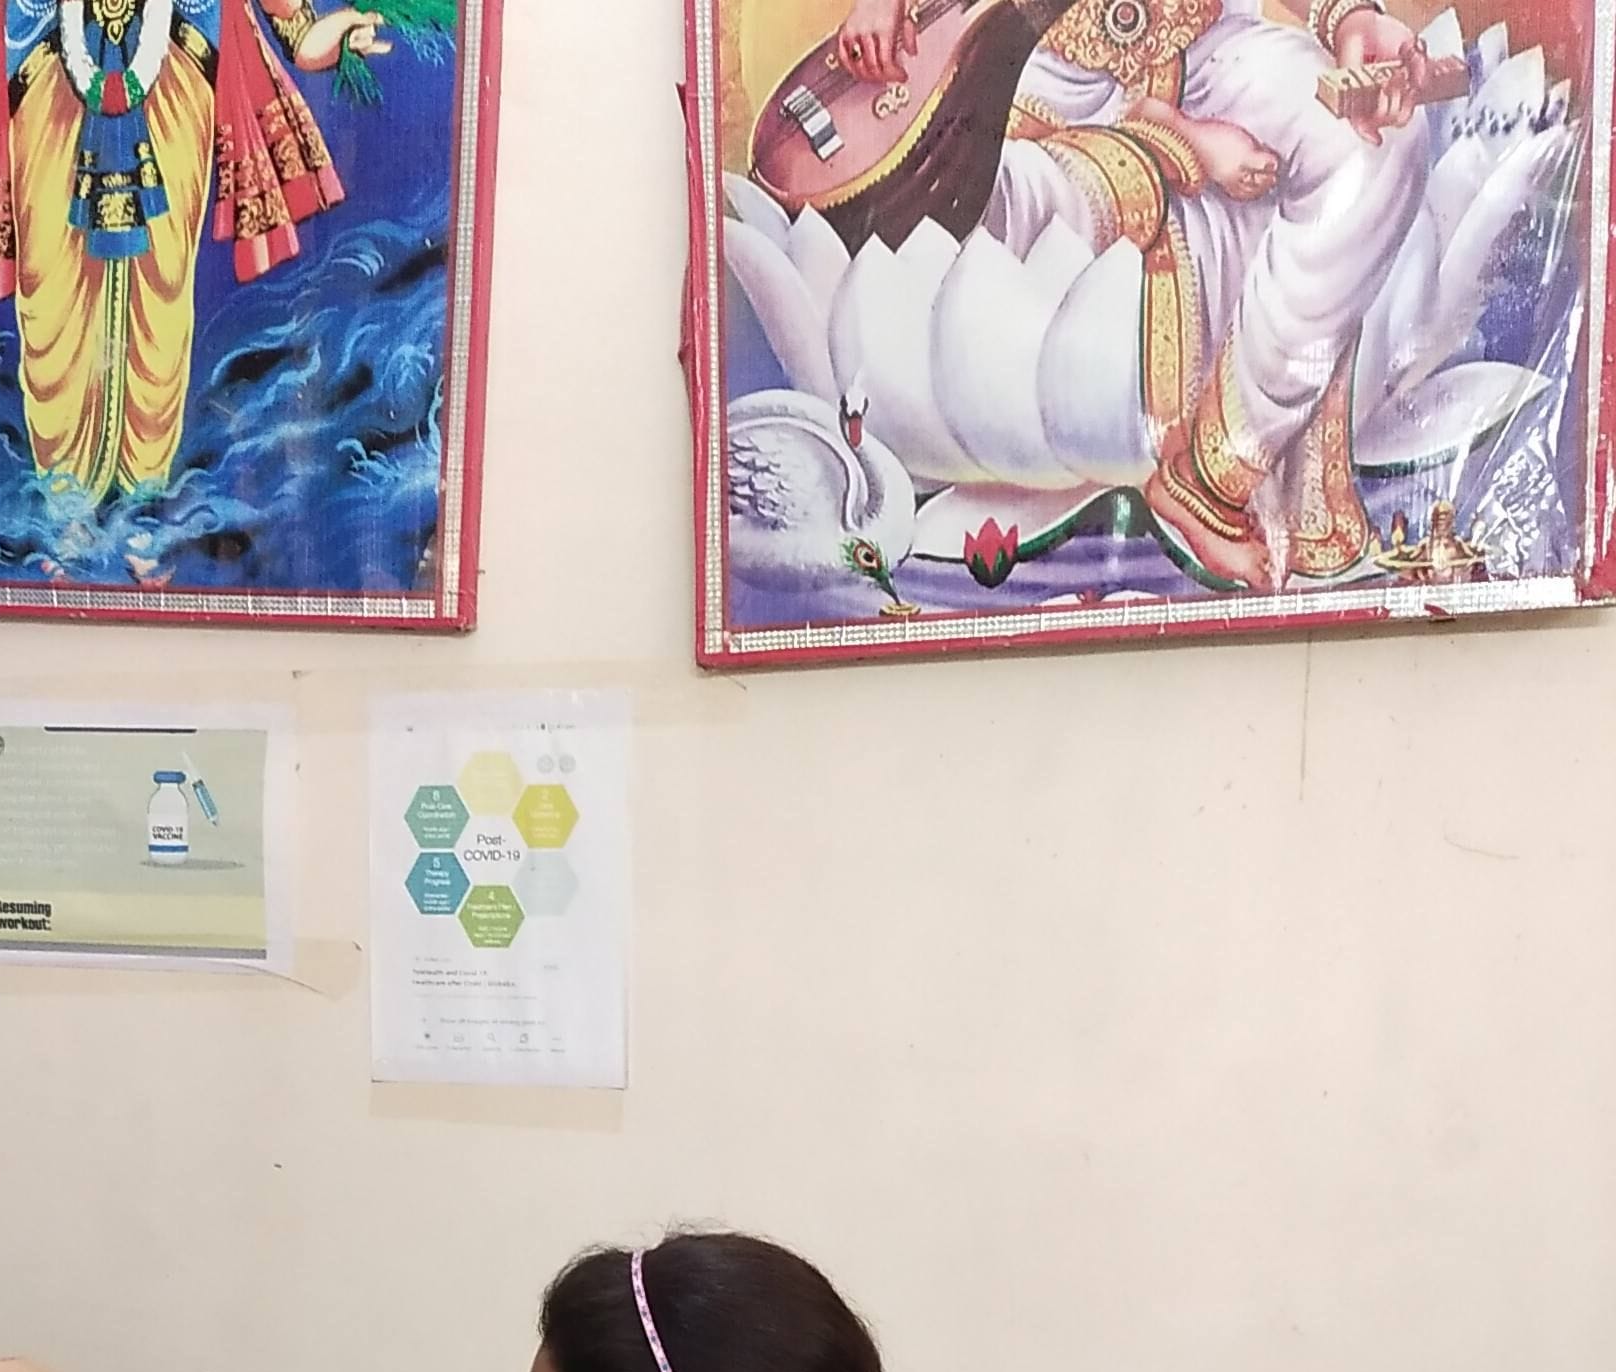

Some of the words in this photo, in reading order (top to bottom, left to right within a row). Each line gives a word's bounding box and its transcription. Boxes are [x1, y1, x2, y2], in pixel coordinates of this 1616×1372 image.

[152, 832, 183, 841] VACCINE
[476, 833, 507, 846] Post-
[463, 849, 521, 862] COVID-19
